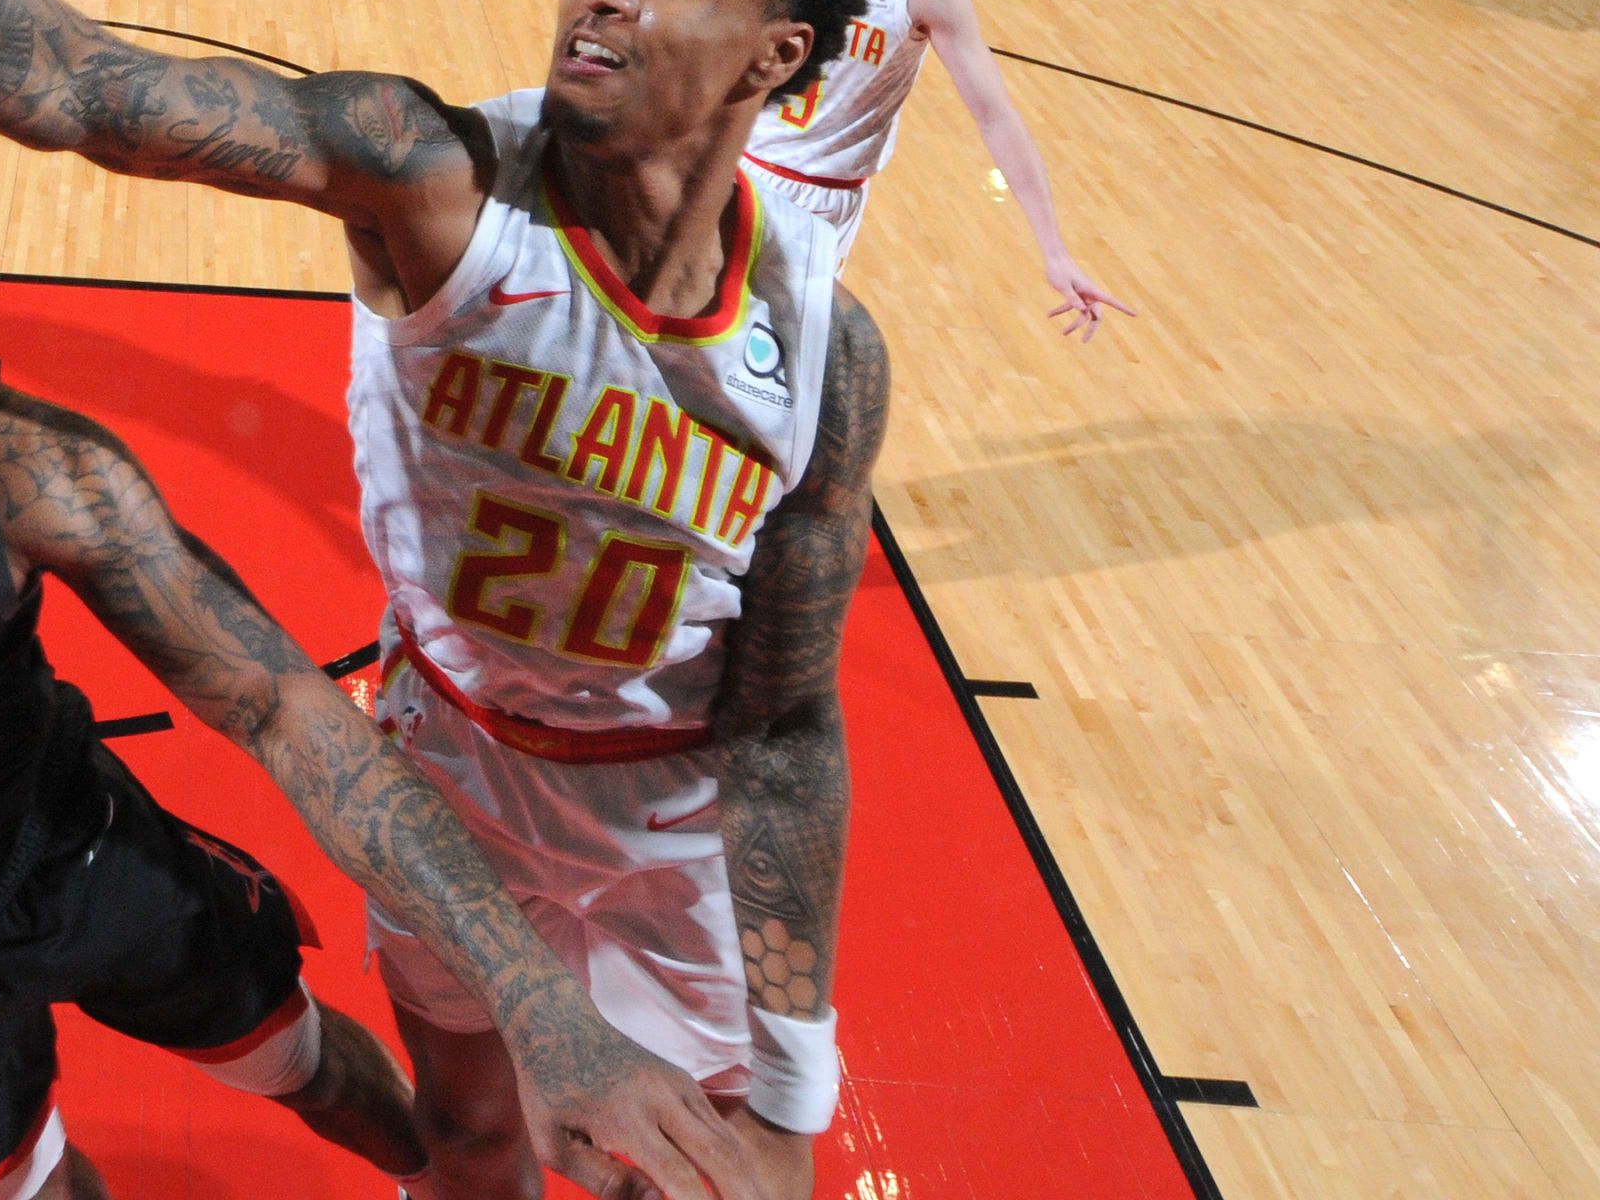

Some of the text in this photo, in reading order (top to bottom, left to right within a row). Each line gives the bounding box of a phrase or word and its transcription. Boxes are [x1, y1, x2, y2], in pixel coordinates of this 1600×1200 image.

[423, 351, 776, 546] ATLANTA
[725, 373, 793, 409] sharecare
[448, 490, 693, 669] 20
